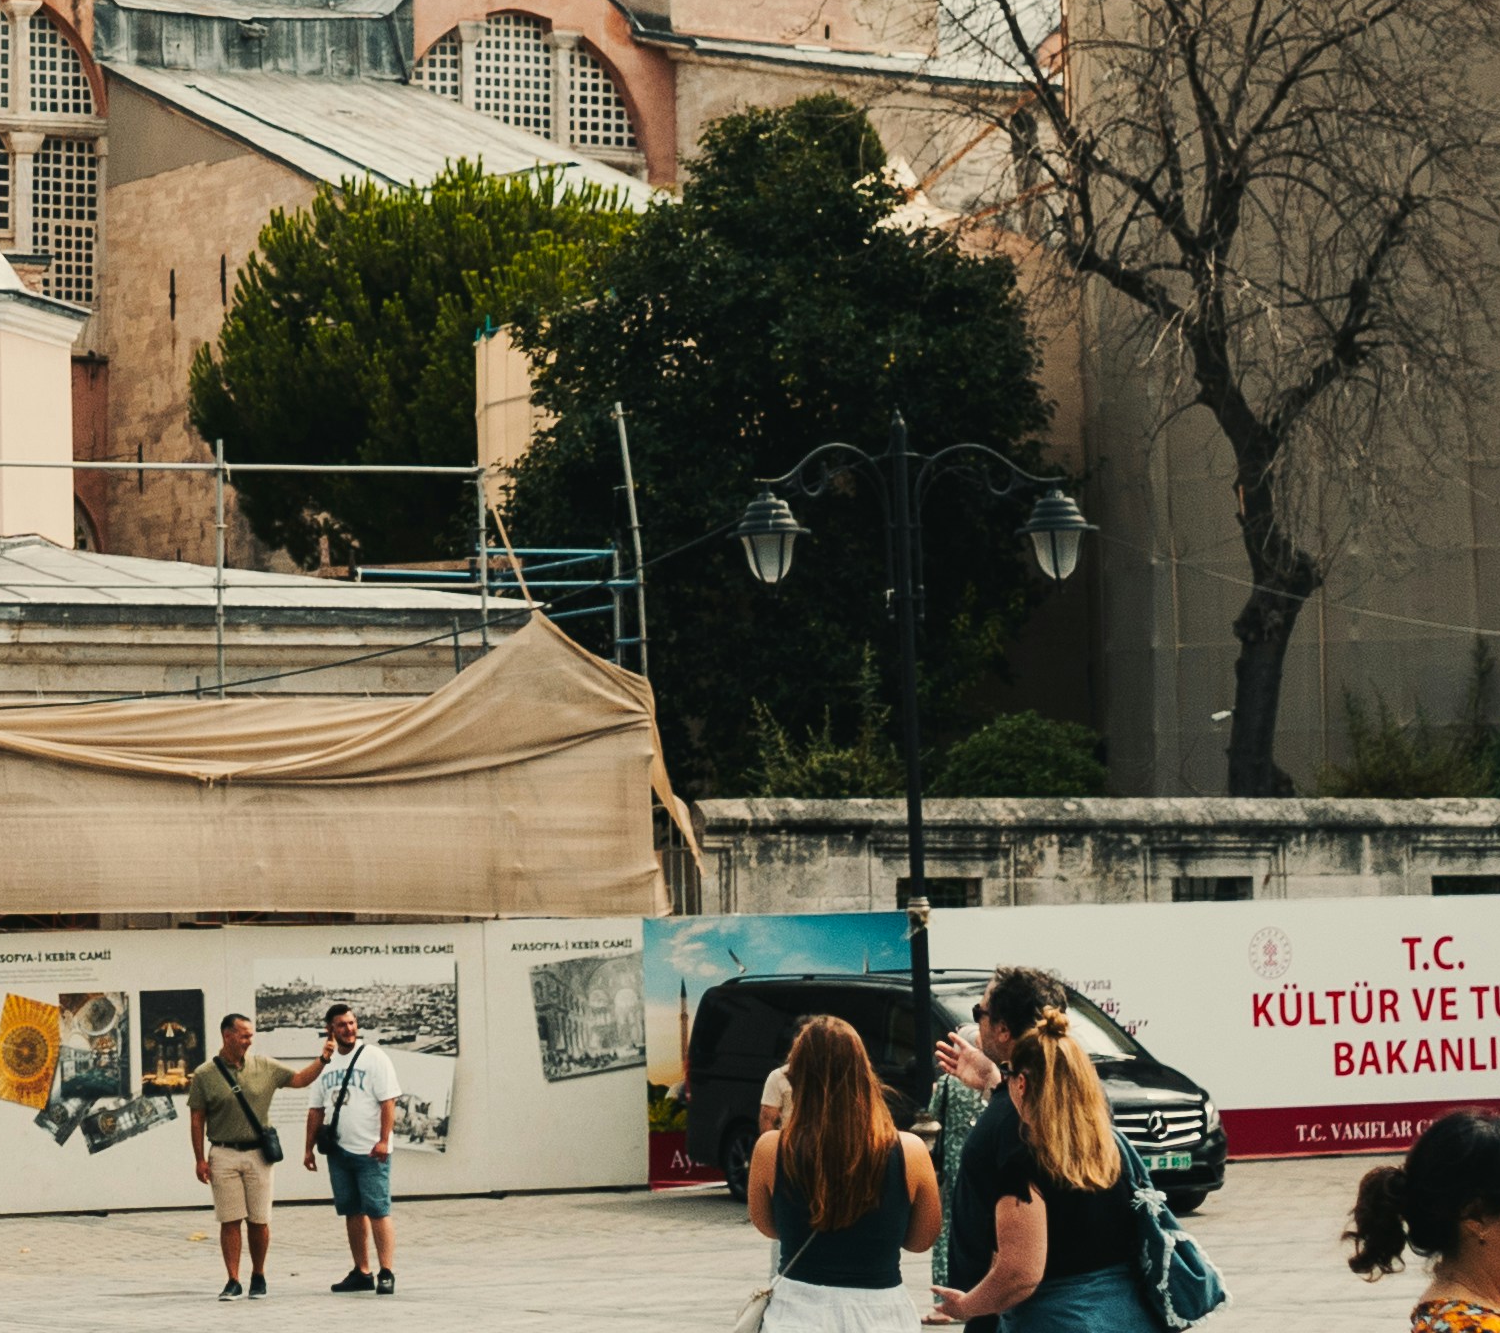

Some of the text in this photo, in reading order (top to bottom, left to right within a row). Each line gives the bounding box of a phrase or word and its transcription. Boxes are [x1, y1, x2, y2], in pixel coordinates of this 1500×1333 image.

[45, 949, 76, 962] KEBİR
[79, 948, 112, 961] CAMİİ
[1401, 935, 1465, 971] T.C.
[1084, 979, 1111, 992] yana
[1252, 981, 1400, 1027] KÜLTÜR
[1412, 986, 1458, 1021] VE
[1296, 1124, 1327, 1142] T.C.
[1331, 1119, 1413, 1141] VAKIFLAR
